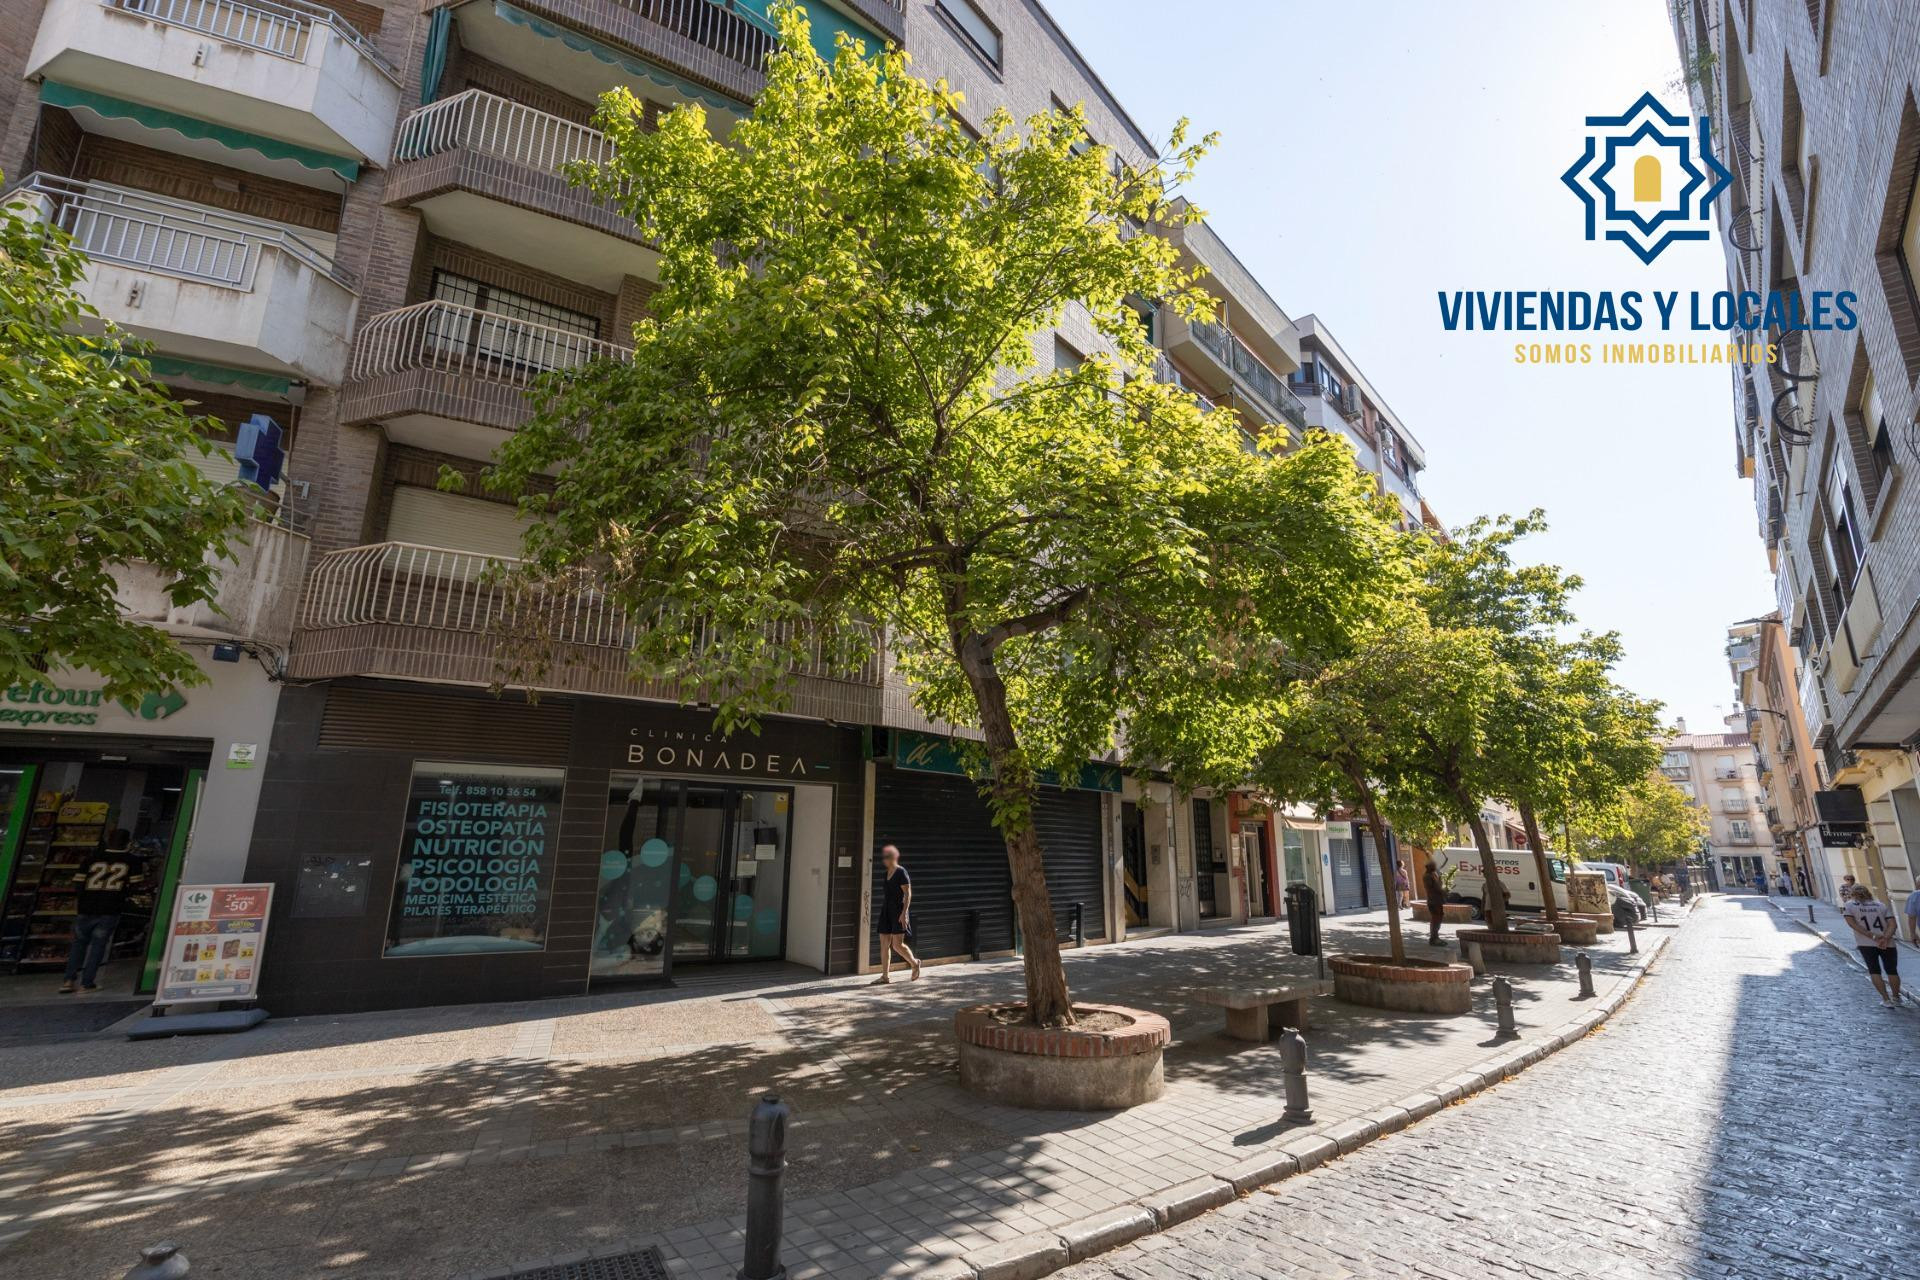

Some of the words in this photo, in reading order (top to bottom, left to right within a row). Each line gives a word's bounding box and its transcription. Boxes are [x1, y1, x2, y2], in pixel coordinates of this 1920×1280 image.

[0, 709, 97, 726] express
[629, 728, 727, 743] CLINICA
[627, 744, 807, 775] BONADEA
[465, 786, 487, 795] 858
[490, 787, 504, 795] 10
[506, 787, 520, 796] 36
[523, 788, 537, 797] 54
[419, 801, 547, 818] FISIOTERAPIA
[417, 818, 545, 835] OSTEOPATÍA
[413, 836, 545, 855] NUTRICIÓN
[411, 856, 540, 874] PSICOLOGÍA
[1459, 861, 1520, 875] Expess
[85, 861, 128, 891] 22
[407, 874, 538, 893] PODOLOGÍA
[405, 894, 474, 905] MEDICINA
[455, 903, 537, 915] TERAPÉUTICO
[1861, 916, 1883, 931] 14
